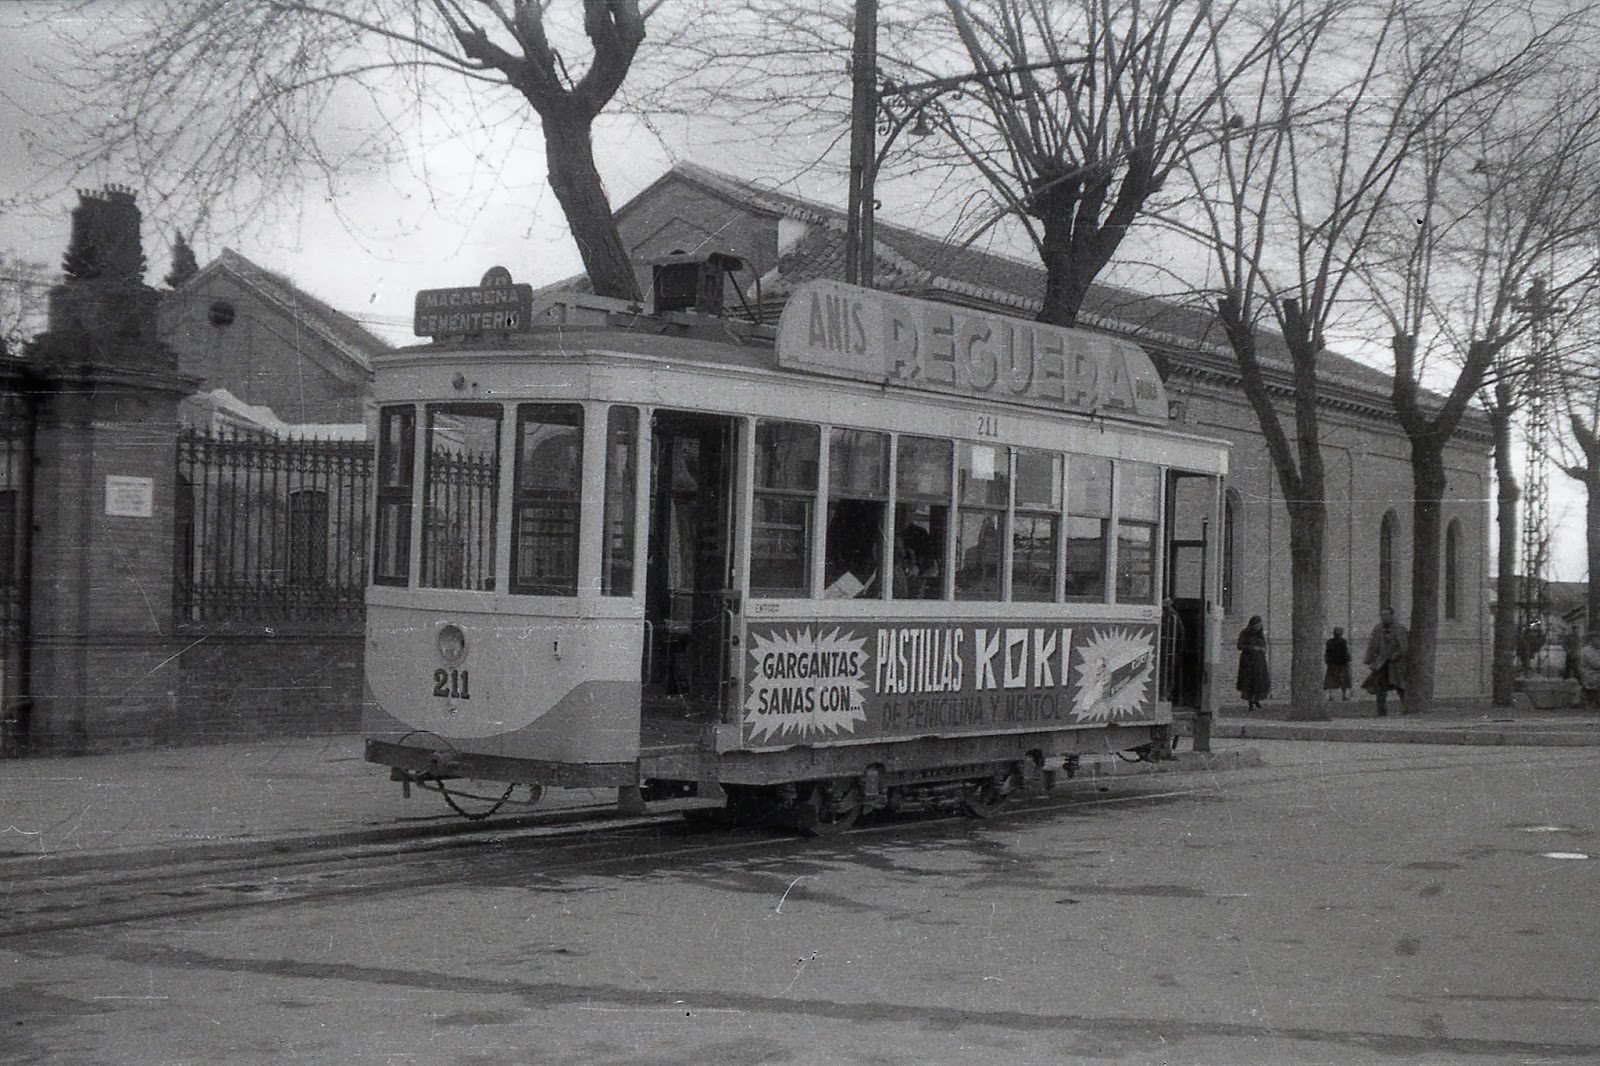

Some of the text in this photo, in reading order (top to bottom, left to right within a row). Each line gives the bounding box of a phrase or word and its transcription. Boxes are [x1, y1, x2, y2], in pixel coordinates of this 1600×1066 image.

[419, 311, 520, 333] CEMENTERIO
[808, 292, 1138, 415] ANIS REGUERA
[977, 416, 999, 438] 211
[763, 651, 859, 679] GARGANTAS
[875, 627, 1073, 694] PASTILLAS KOKI
[433, 668, 470, 700] 211
[758, 685, 861, 715] SANAS CON...
